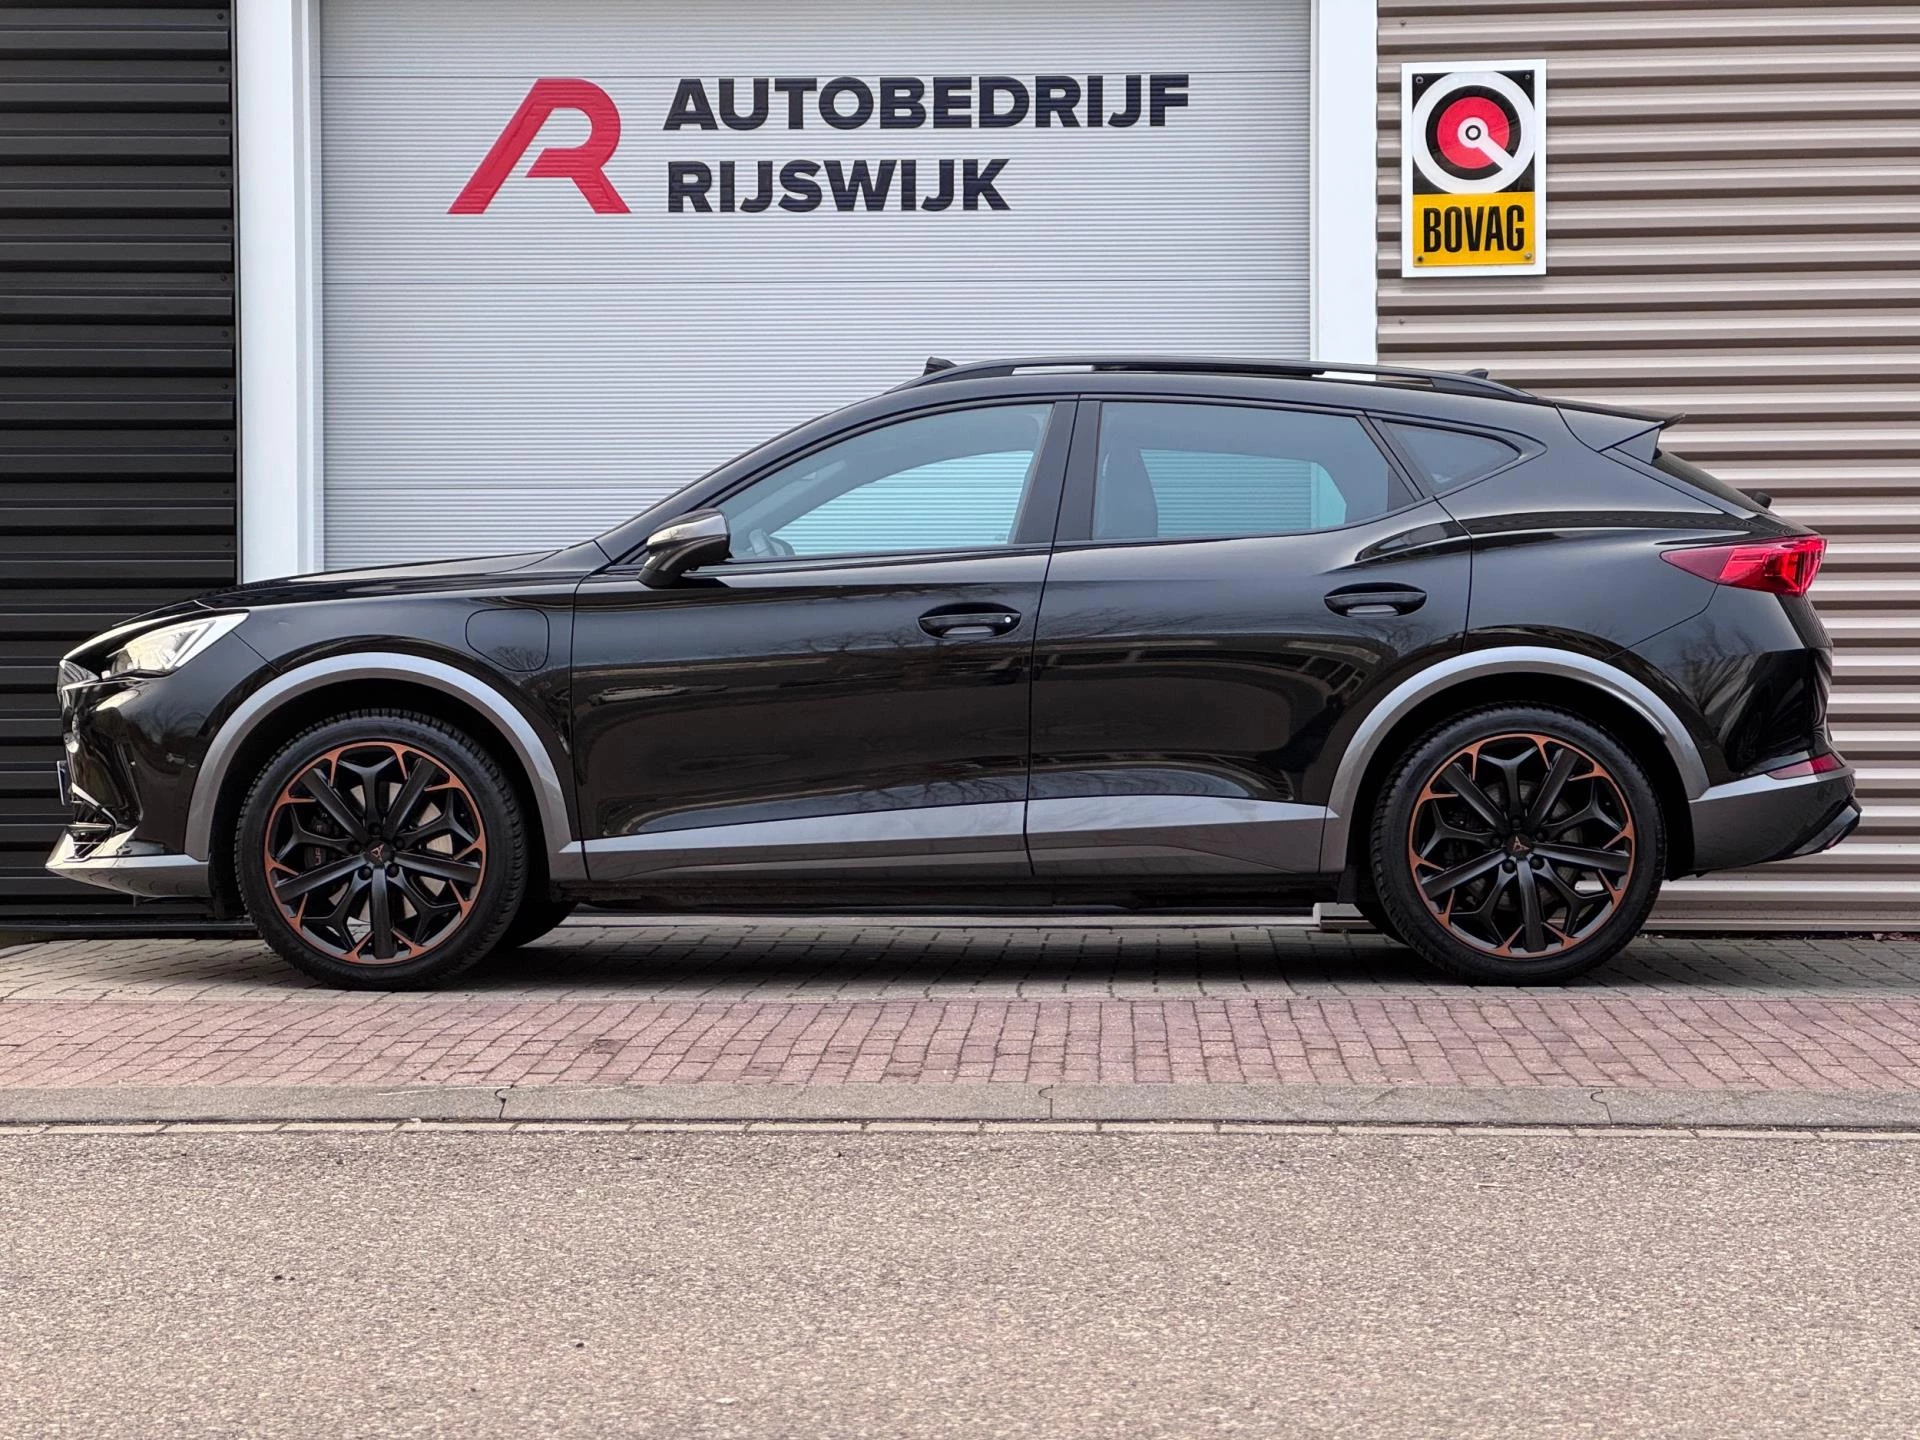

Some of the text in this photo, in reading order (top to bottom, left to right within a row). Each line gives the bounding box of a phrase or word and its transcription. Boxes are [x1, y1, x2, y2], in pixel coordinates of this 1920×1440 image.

[663, 73, 1188, 130] AUTOBEDRIJF
[667, 159, 1011, 213] RIJSWIJK
[1423, 205, 1525, 252] BOVAG
